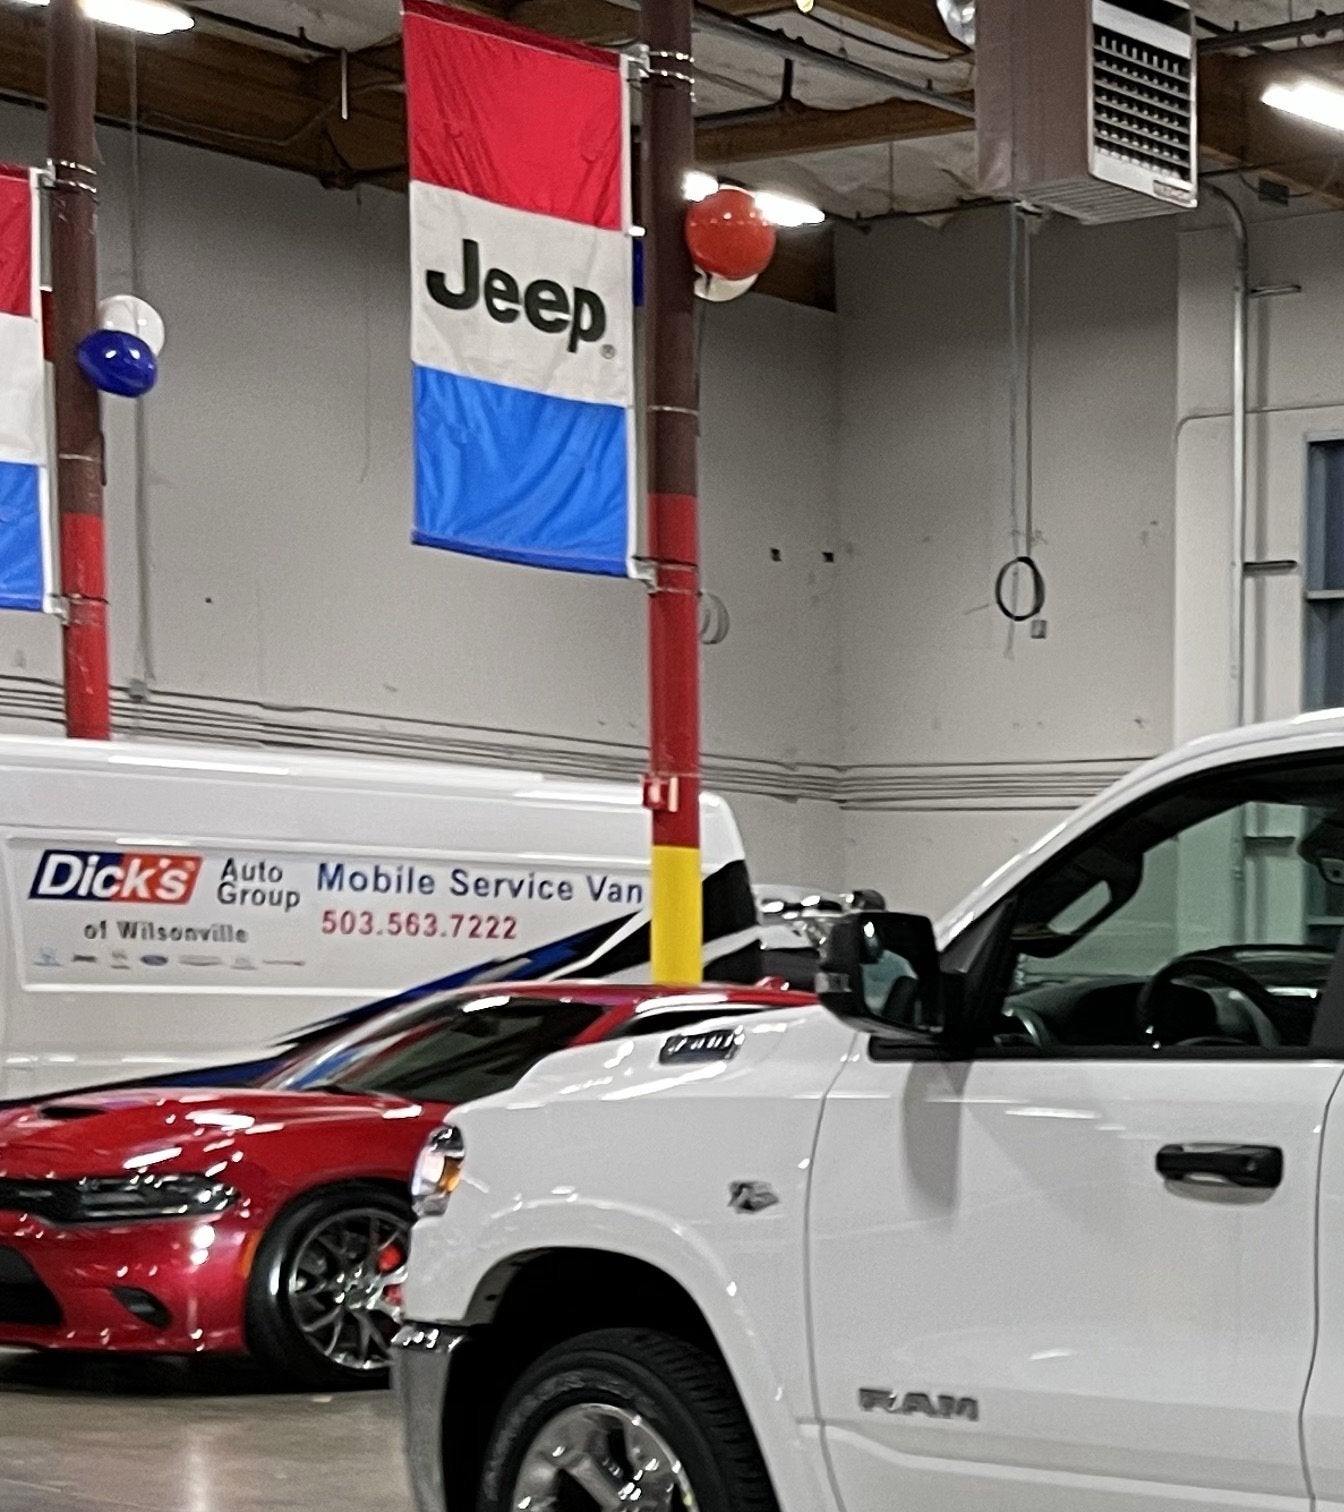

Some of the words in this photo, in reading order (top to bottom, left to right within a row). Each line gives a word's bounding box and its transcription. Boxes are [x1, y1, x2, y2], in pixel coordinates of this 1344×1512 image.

[426, 238, 607, 353] Jeep
[37, 853, 188, 901] Dick's
[221, 857, 283, 883] Auto
[317, 863, 435, 894] Mobile
[450, 869, 573, 901] Service
[588, 875, 643, 904] Van
[217, 881, 300, 912] Group
[84, 920, 107, 940] of
[117, 921, 248, 943] Wilsonville
[321, 910, 518, 940] 503.563.7222
[858, 1388, 978, 1421] RAM
